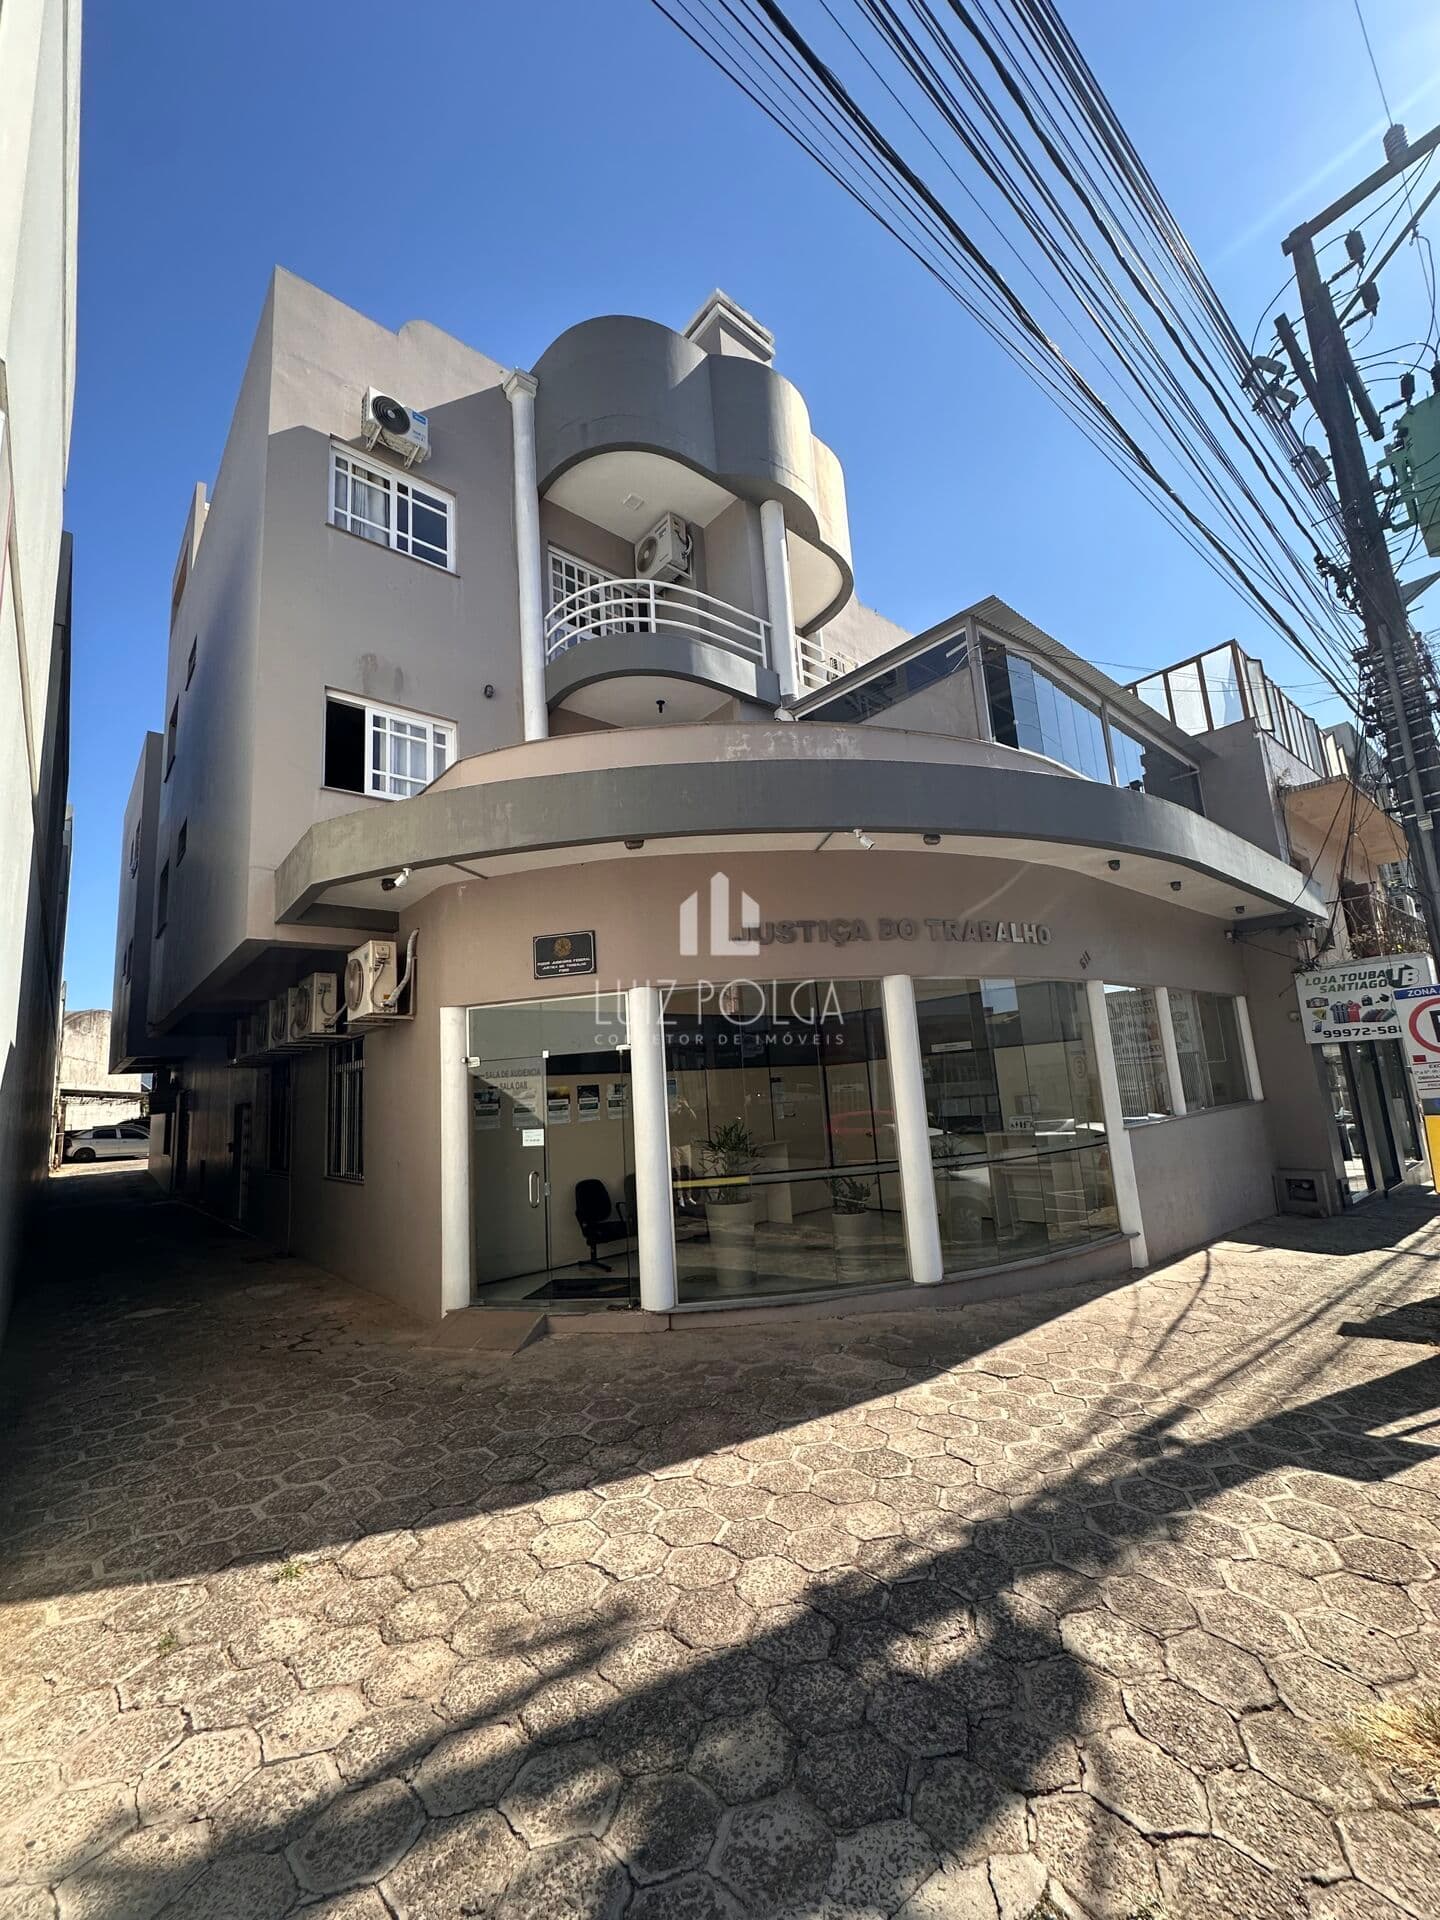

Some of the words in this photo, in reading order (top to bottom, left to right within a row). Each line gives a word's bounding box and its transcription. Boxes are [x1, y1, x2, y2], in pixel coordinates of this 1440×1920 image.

[731, 919, 871, 947] JUSTIÇA
[878, 917, 914, 942] DO
[924, 919, 1051, 945] TRABALHO
[1305, 975, 1337, 987] LOJA
[1340, 969, 1387, 981] TOUBA
[1319, 979, 1388, 994] SANTIAGO
[1407, 987, 1438, 997] ZONA
[1322, 1024, 1402, 1039] 99972-58
